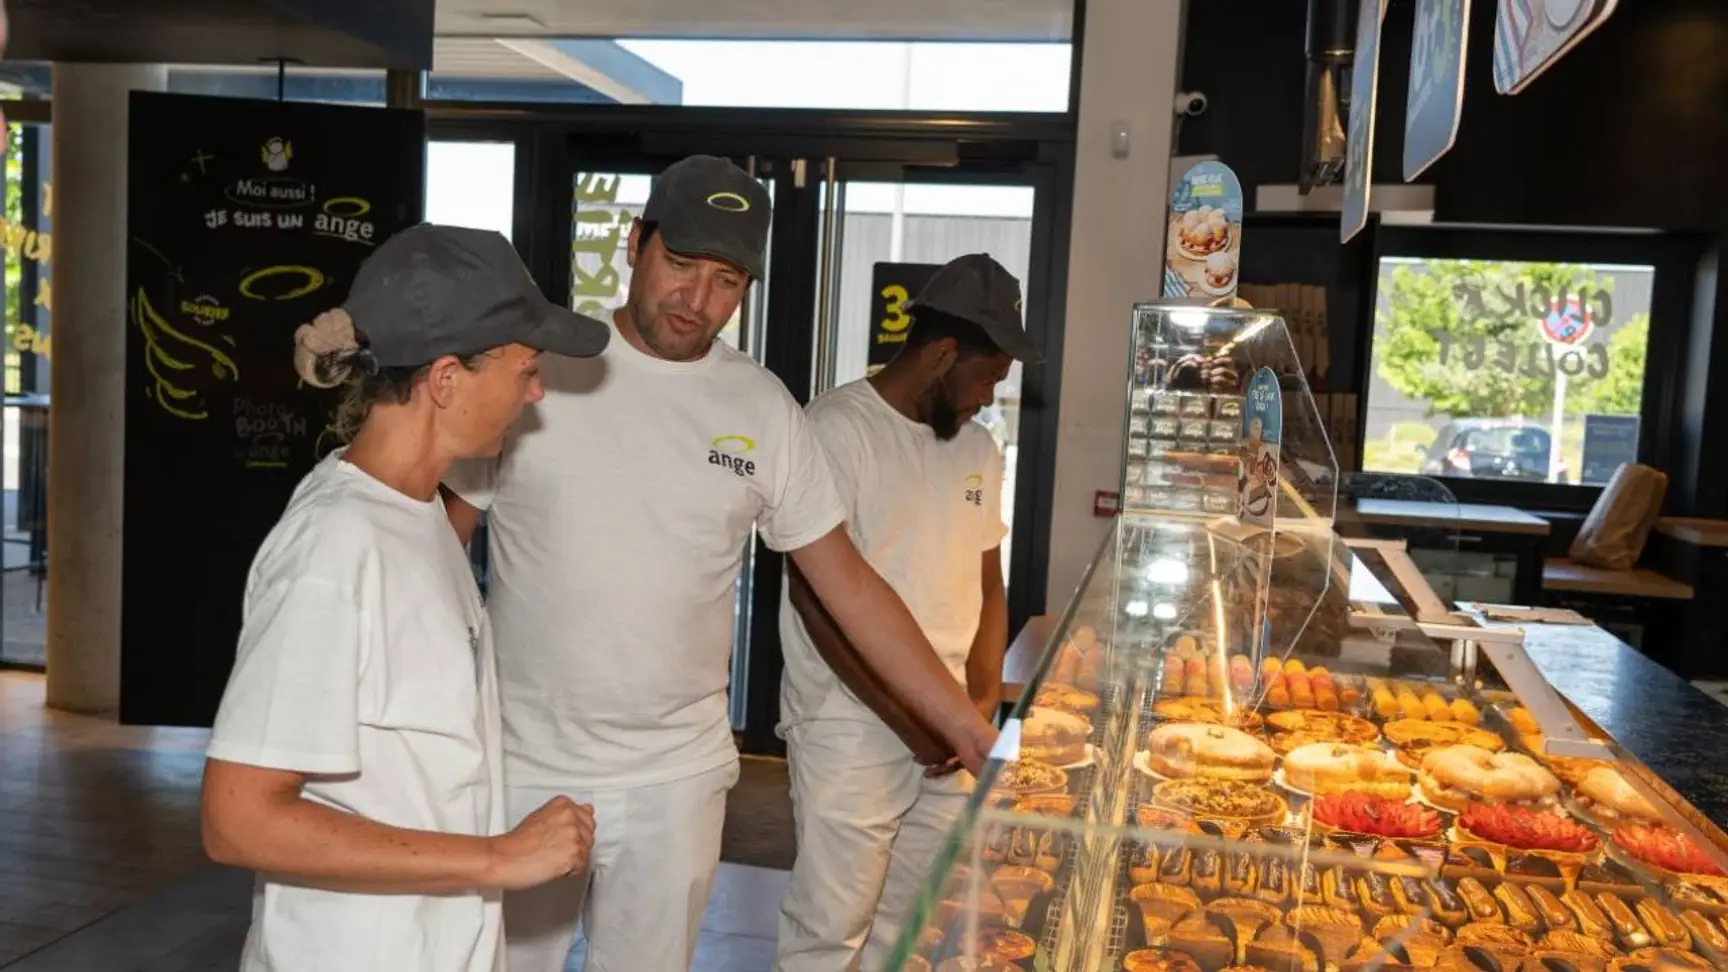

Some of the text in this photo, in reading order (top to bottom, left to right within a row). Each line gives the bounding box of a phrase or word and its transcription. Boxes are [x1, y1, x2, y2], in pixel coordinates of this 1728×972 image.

[236, 178, 267, 197] Moi
[269, 183, 306, 200] aussi
[233, 210, 273, 228] SUIS
[276, 213, 304, 230] UN
[314, 212, 375, 241] ange
[881, 284, 910, 332] 3
[708, 449, 756, 477] ange
